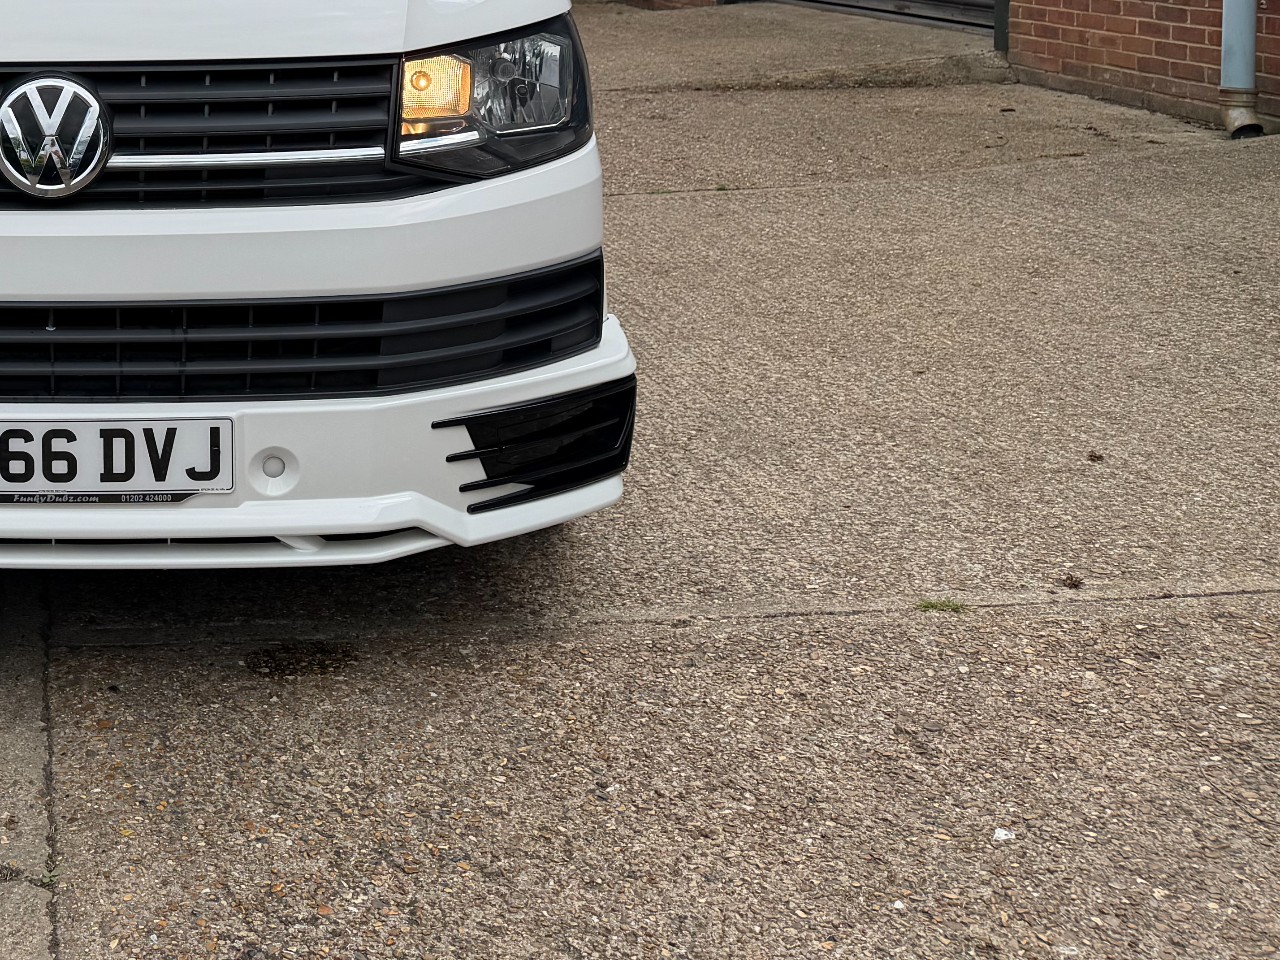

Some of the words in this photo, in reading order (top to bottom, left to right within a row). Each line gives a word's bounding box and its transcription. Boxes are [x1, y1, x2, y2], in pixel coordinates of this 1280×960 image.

[99, 426, 221, 482] DVJ
[13, 494, 99, 503] FunkyDubz.com
[121, 494, 144, 502] 01202
[145, 494, 172, 502] 424000
